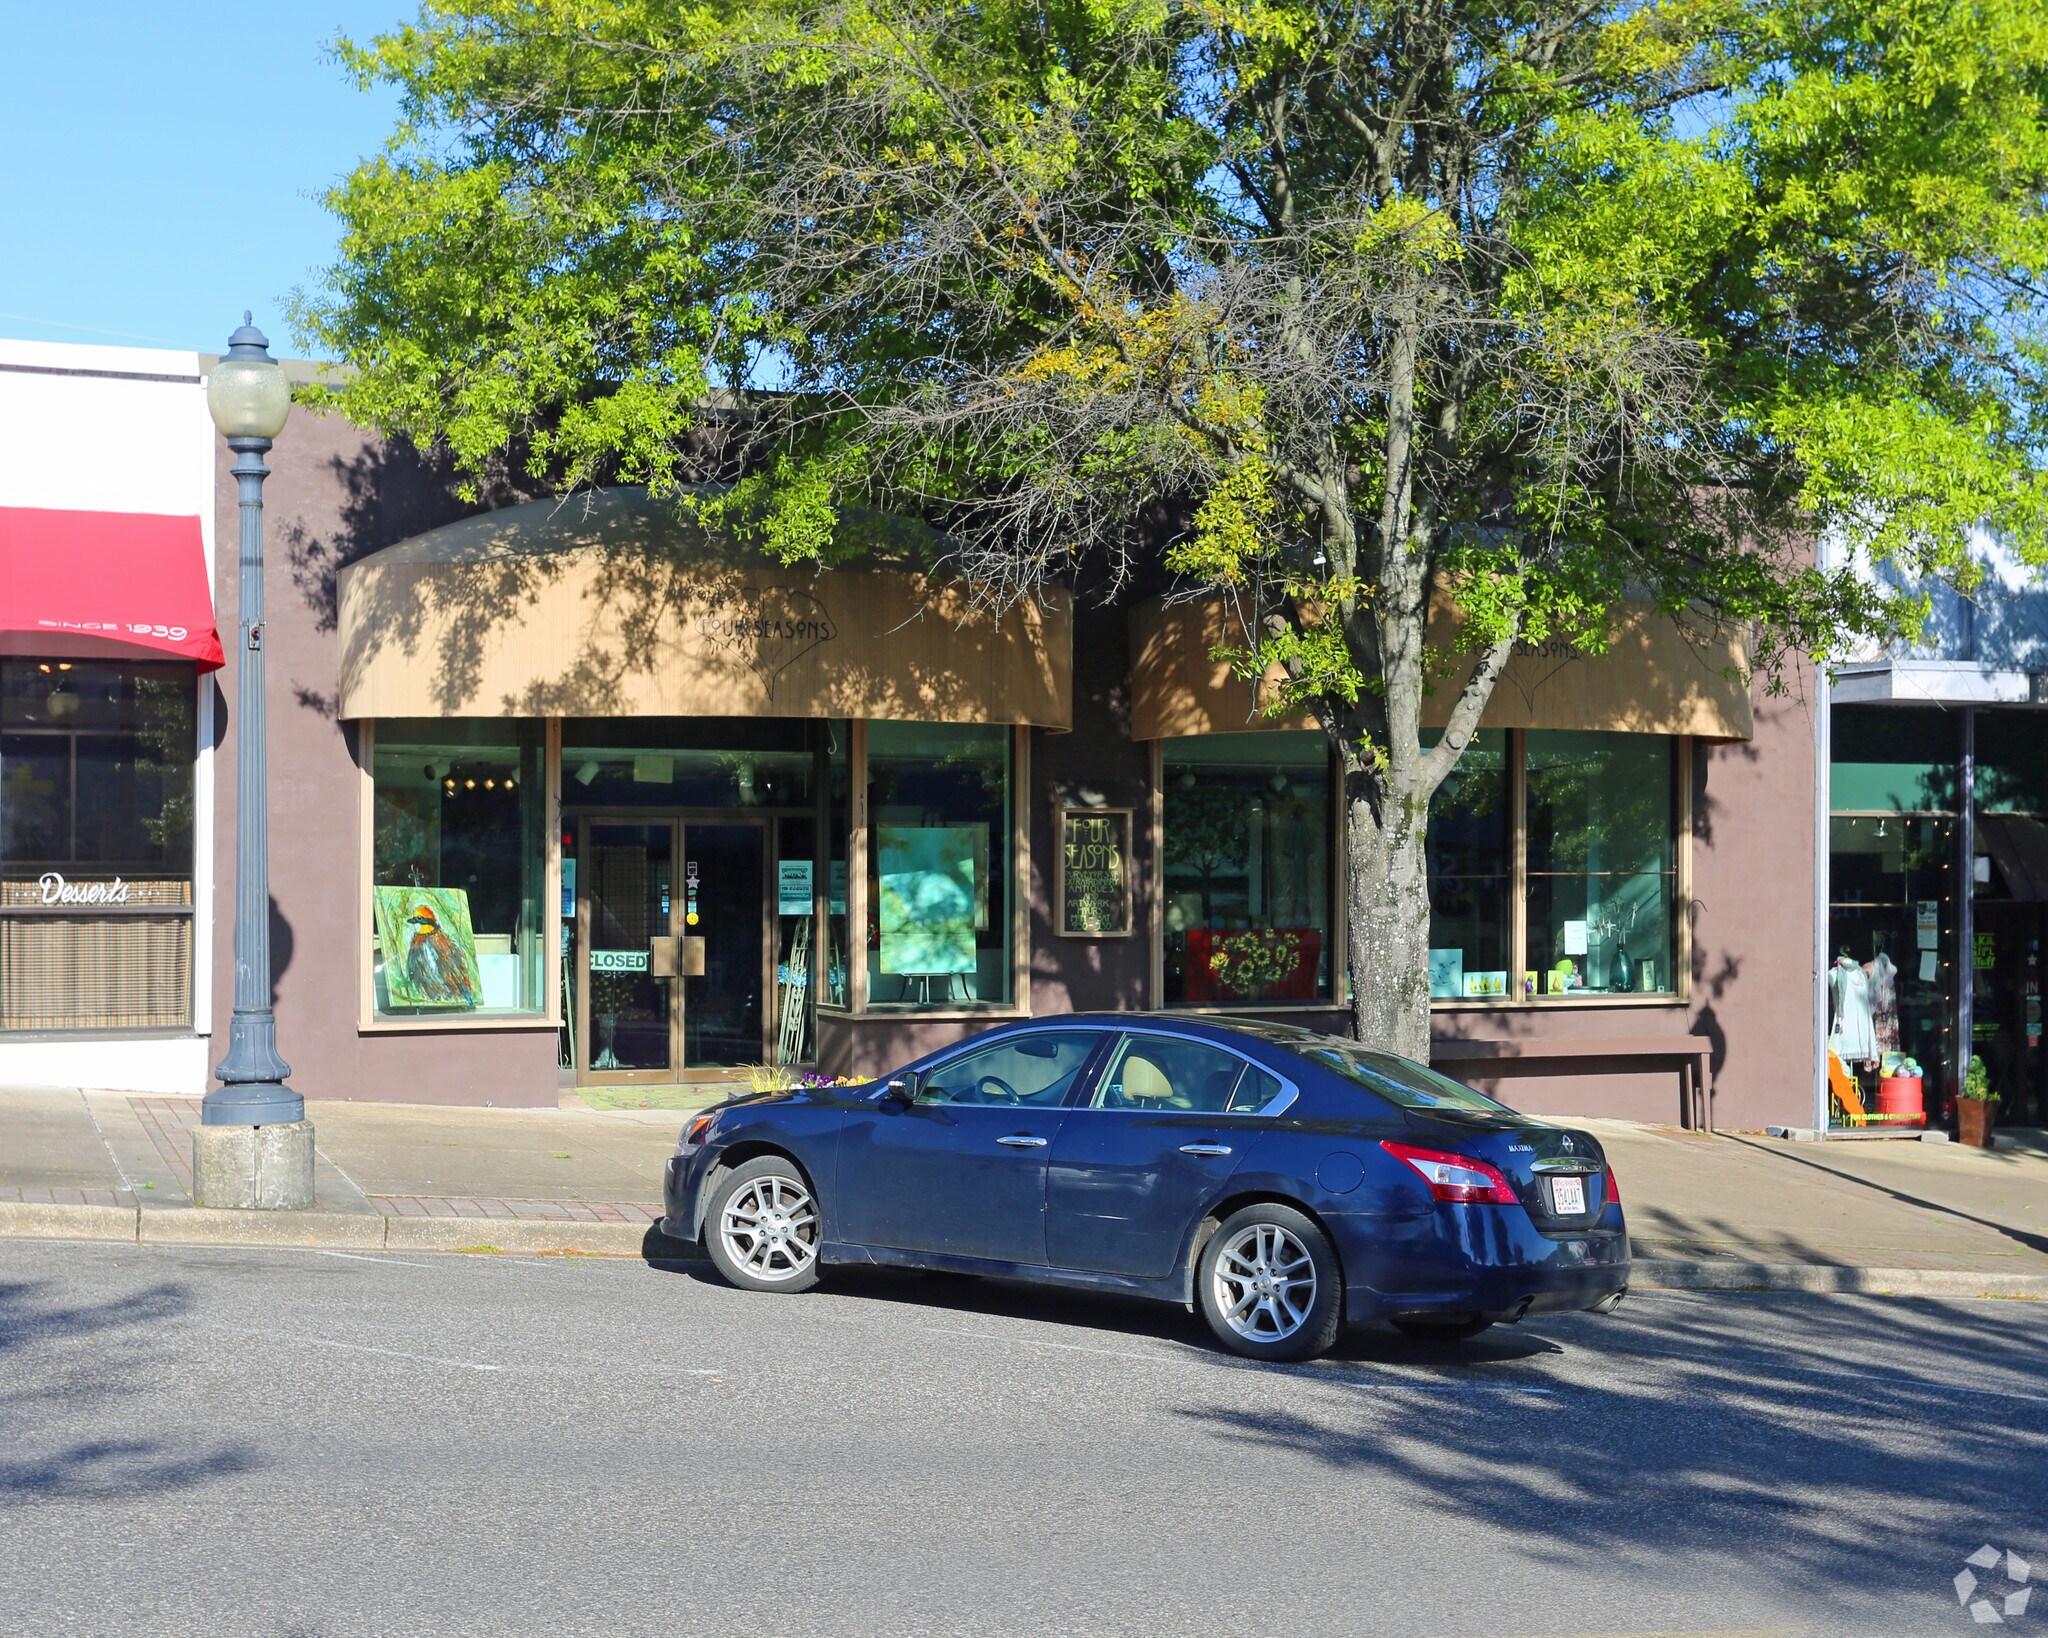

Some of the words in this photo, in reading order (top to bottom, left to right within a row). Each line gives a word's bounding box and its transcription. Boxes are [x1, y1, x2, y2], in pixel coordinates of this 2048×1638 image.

[38, 620, 118, 631] SINCE
[125, 624, 187, 641] 1939
[754, 619, 829, 641] SEASONS
[1073, 818, 1110, 843] FOUR
[1064, 844, 1120, 869] SEASONS
[39, 872, 130, 904] Desserts
[1068, 885, 1115, 893] ANTIQUES
